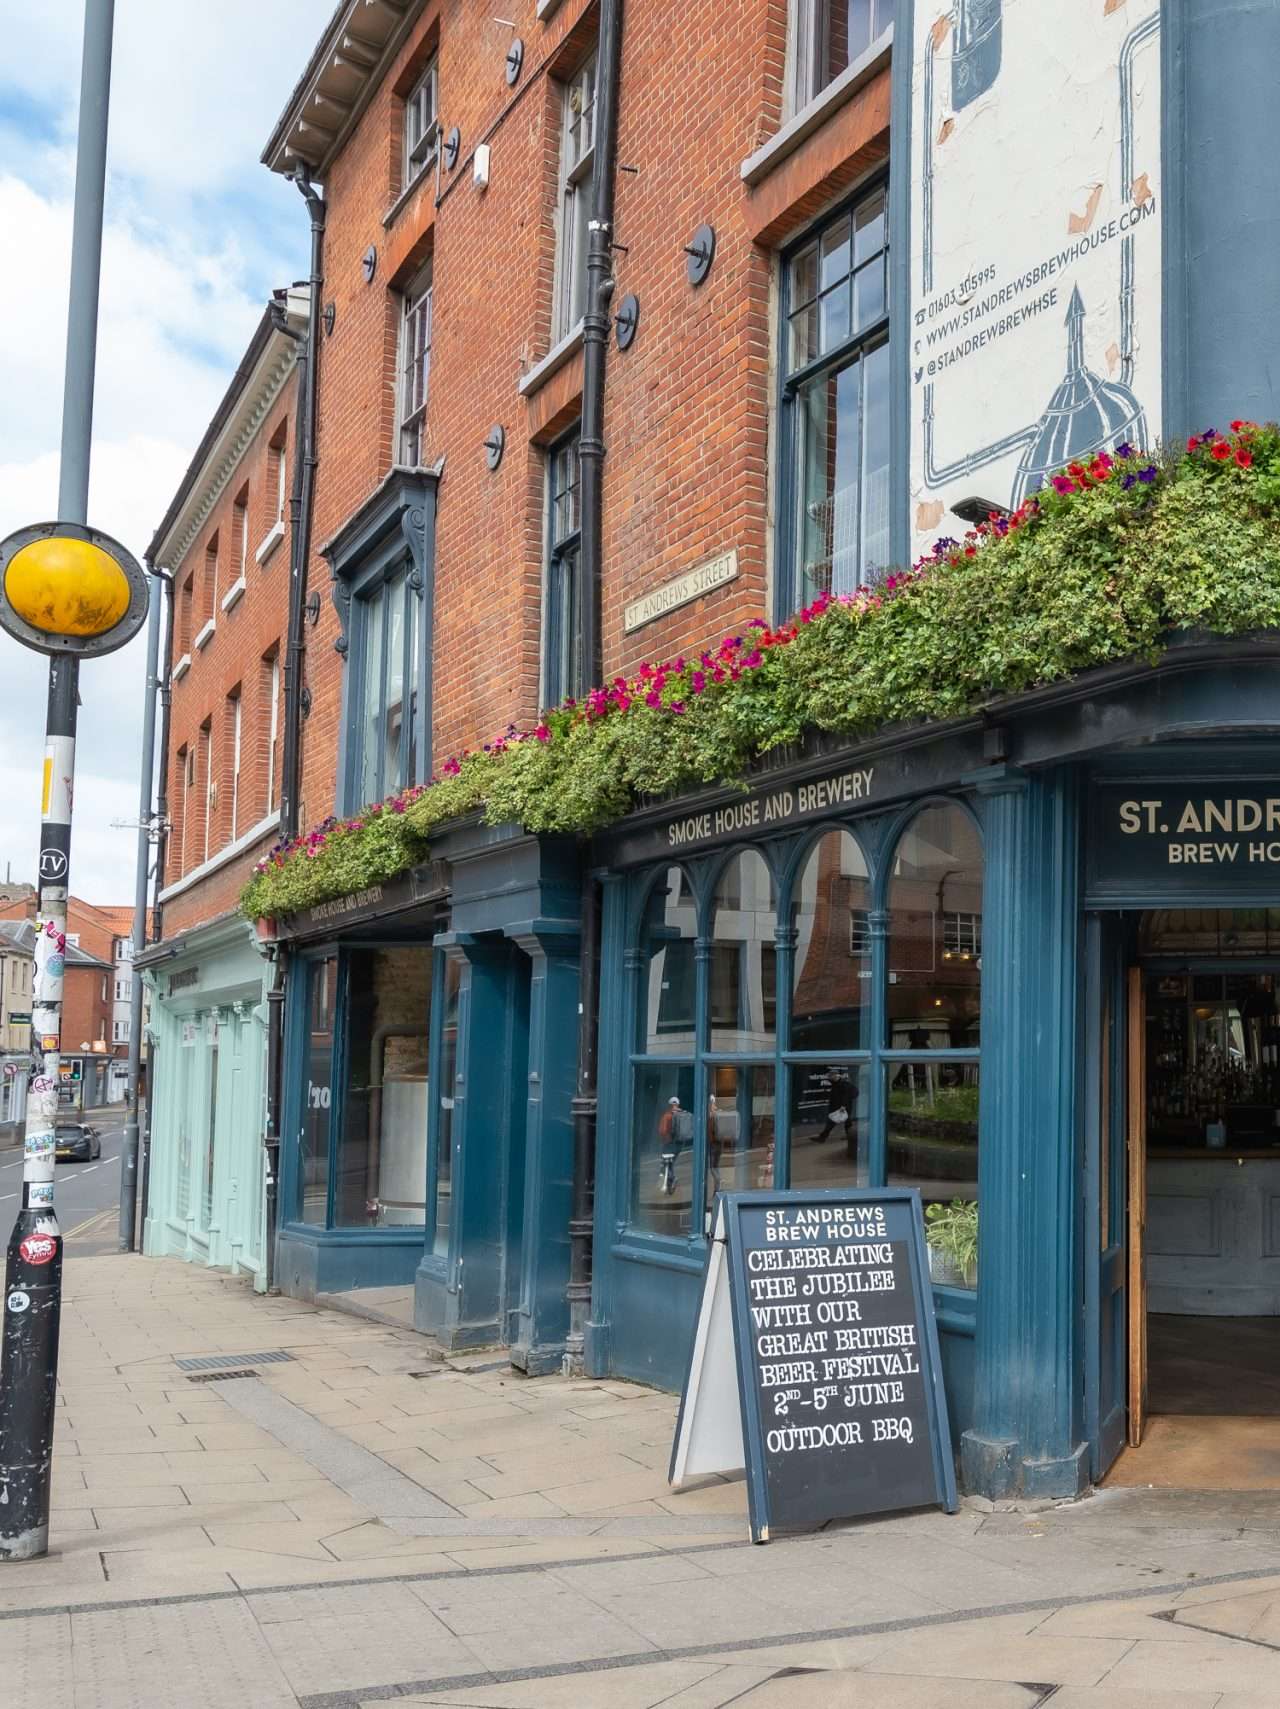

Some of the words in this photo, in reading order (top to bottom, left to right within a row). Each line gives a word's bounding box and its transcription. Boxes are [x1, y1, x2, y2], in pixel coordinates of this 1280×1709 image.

[926, 197, 1156, 346] WWW.STANDREWSBREWHOUSE.COM
[928, 287, 957, 318] 01603
[927, 287, 1058, 375] @STANDREWBREWHSE
[628, 606, 638, 627] ST
[643, 580, 689, 619] ANDREWS
[694, 556, 731, 593] STREET
[668, 814, 711, 846] SMOKE
[715, 800, 760, 834] HOUSE
[764, 791, 793, 822] AND
[799, 767, 874, 813] BREWERY
[1119, 800, 1169, 834] ST.
[1168, 842, 1240, 864] BREW
[766, 1210, 792, 1226] ST.
[795, 1207, 885, 1225] ANDREWS
[766, 1226, 820, 1241] BREW
[827, 1223, 887, 1239] HOUSE
[748, 1243, 894, 1272] CELEBRATING
[751, 1276, 797, 1300] THE
[802, 1270, 895, 1296] JUBILEE
[752, 1304, 812, 1329] WITH
[817, 1300, 862, 1323] OUR
[757, 1331, 828, 1358] GREAT
[835, 1325, 916, 1351] BRITISH
[760, 1363, 818, 1387] BEER
[821, 1353, 919, 1381] FESTIVAL
[844, 1381, 904, 1407] JUNE
[767, 1422, 863, 1453] OUTDOOR
[872, 1417, 914, 1444] BBQ
